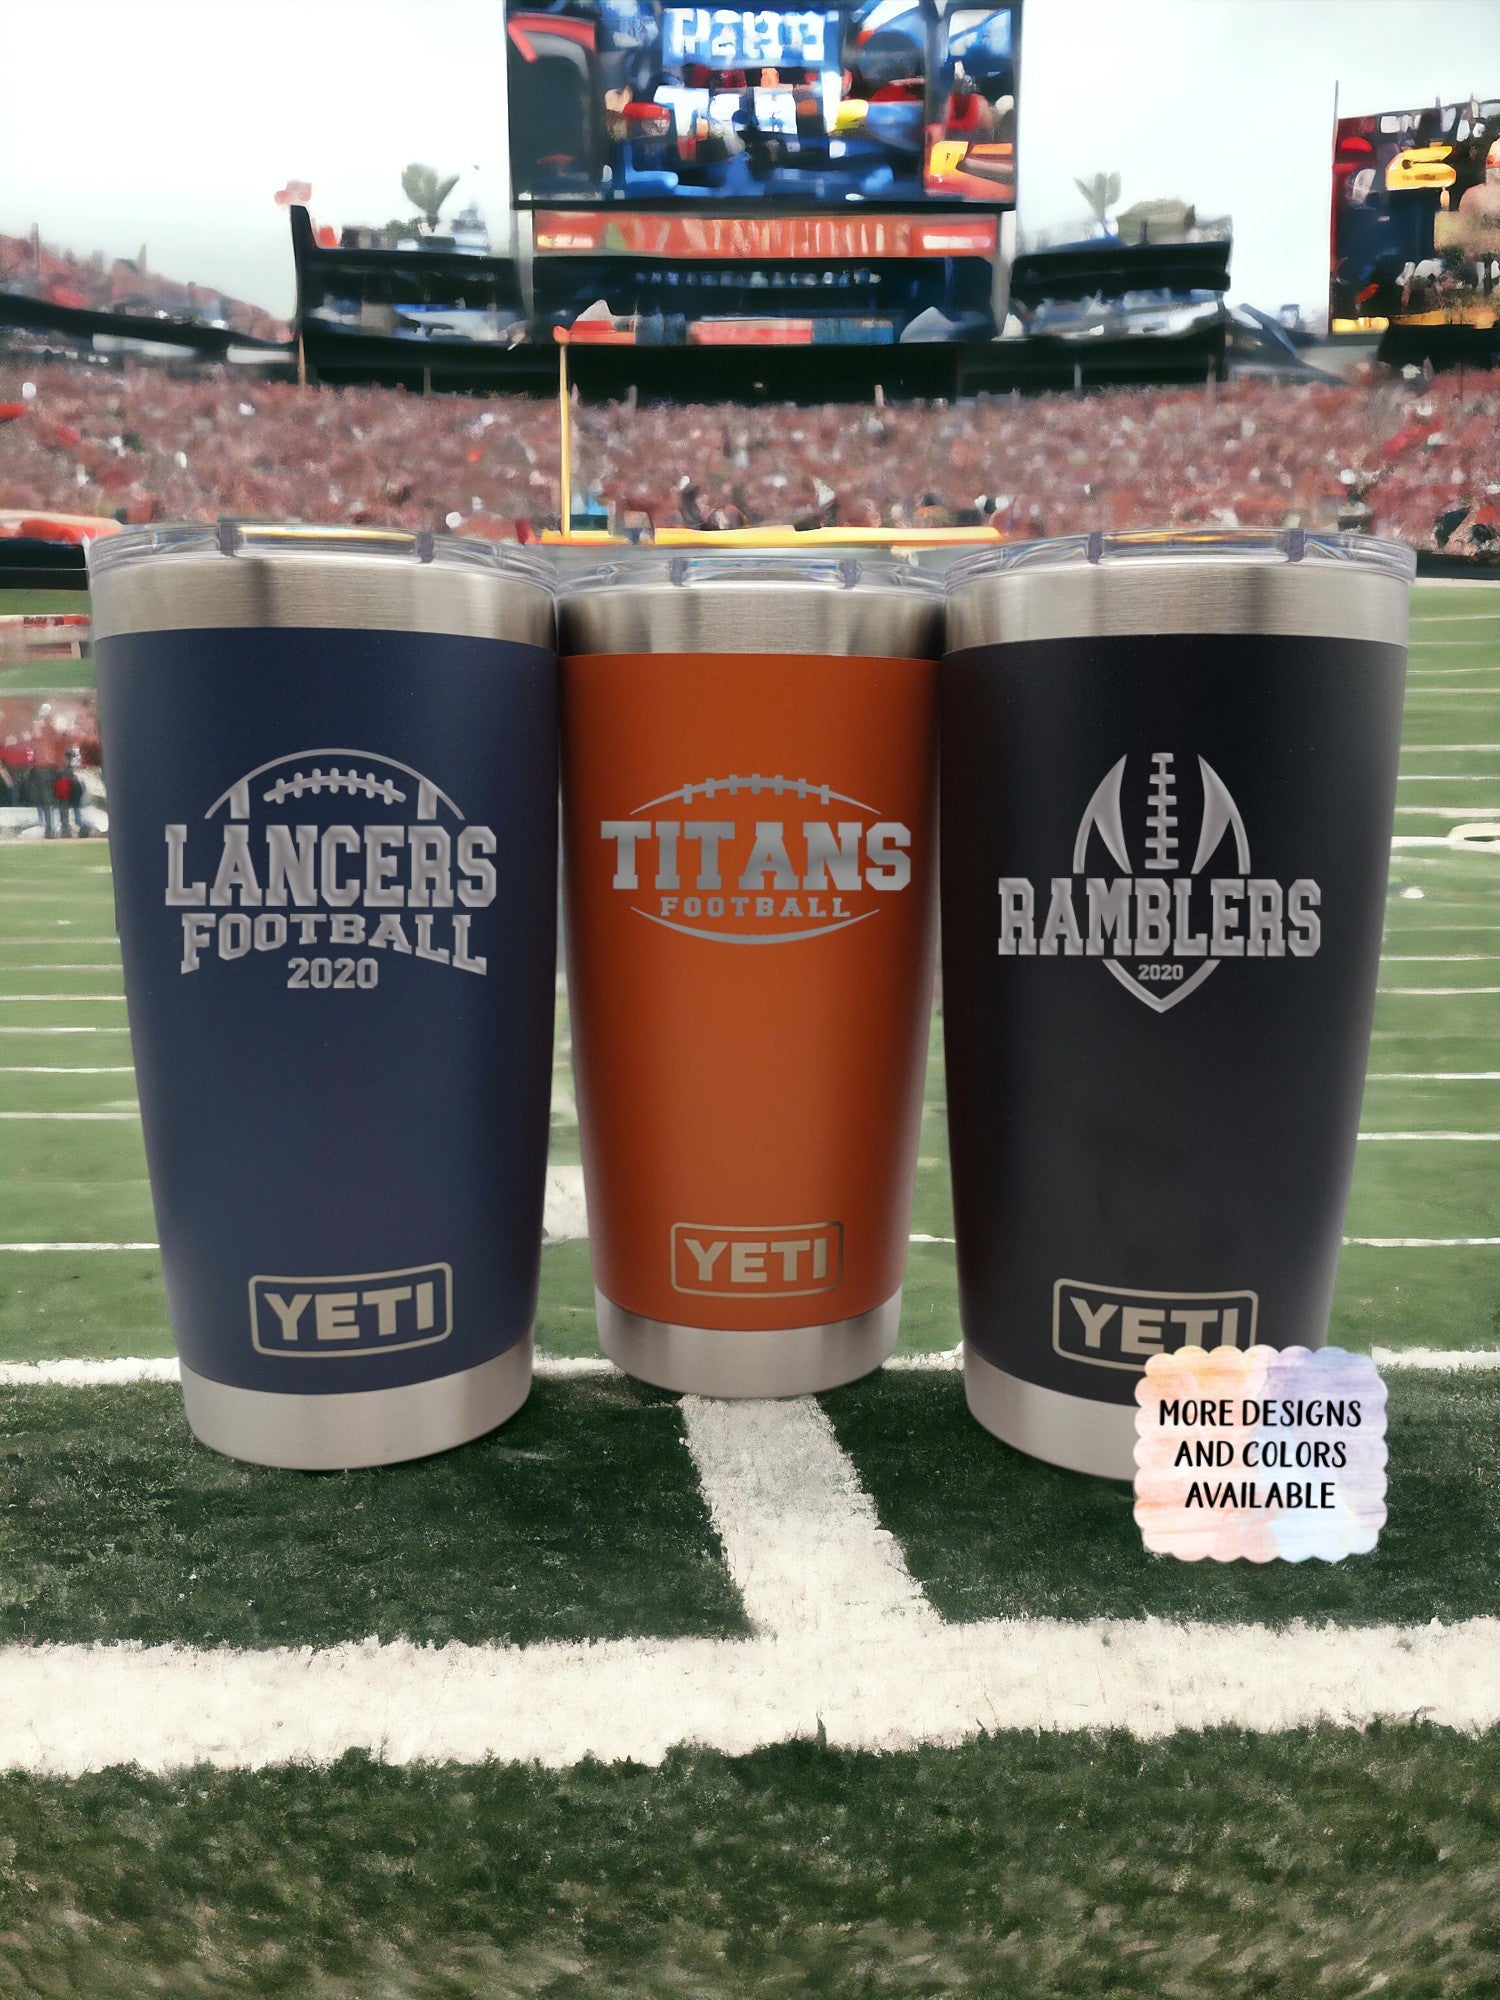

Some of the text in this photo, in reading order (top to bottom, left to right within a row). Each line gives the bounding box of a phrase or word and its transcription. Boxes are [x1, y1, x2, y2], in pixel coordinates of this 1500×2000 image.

[165, 824, 496, 907] LANCERS
[601, 821, 911, 891] TITANS
[661, 897, 850, 918] FOOTBALL
[998, 877, 1321, 957] RAMBLERS
[181, 913, 487, 976] FOOTBALL
[287, 957, 378, 989] 2020
[1138, 964, 1184, 981] 2020
[684, 1237, 827, 1283] YETI
[263, 1282, 434, 1341] YETI
[1069, 1296, 1239, 1355] YETI
